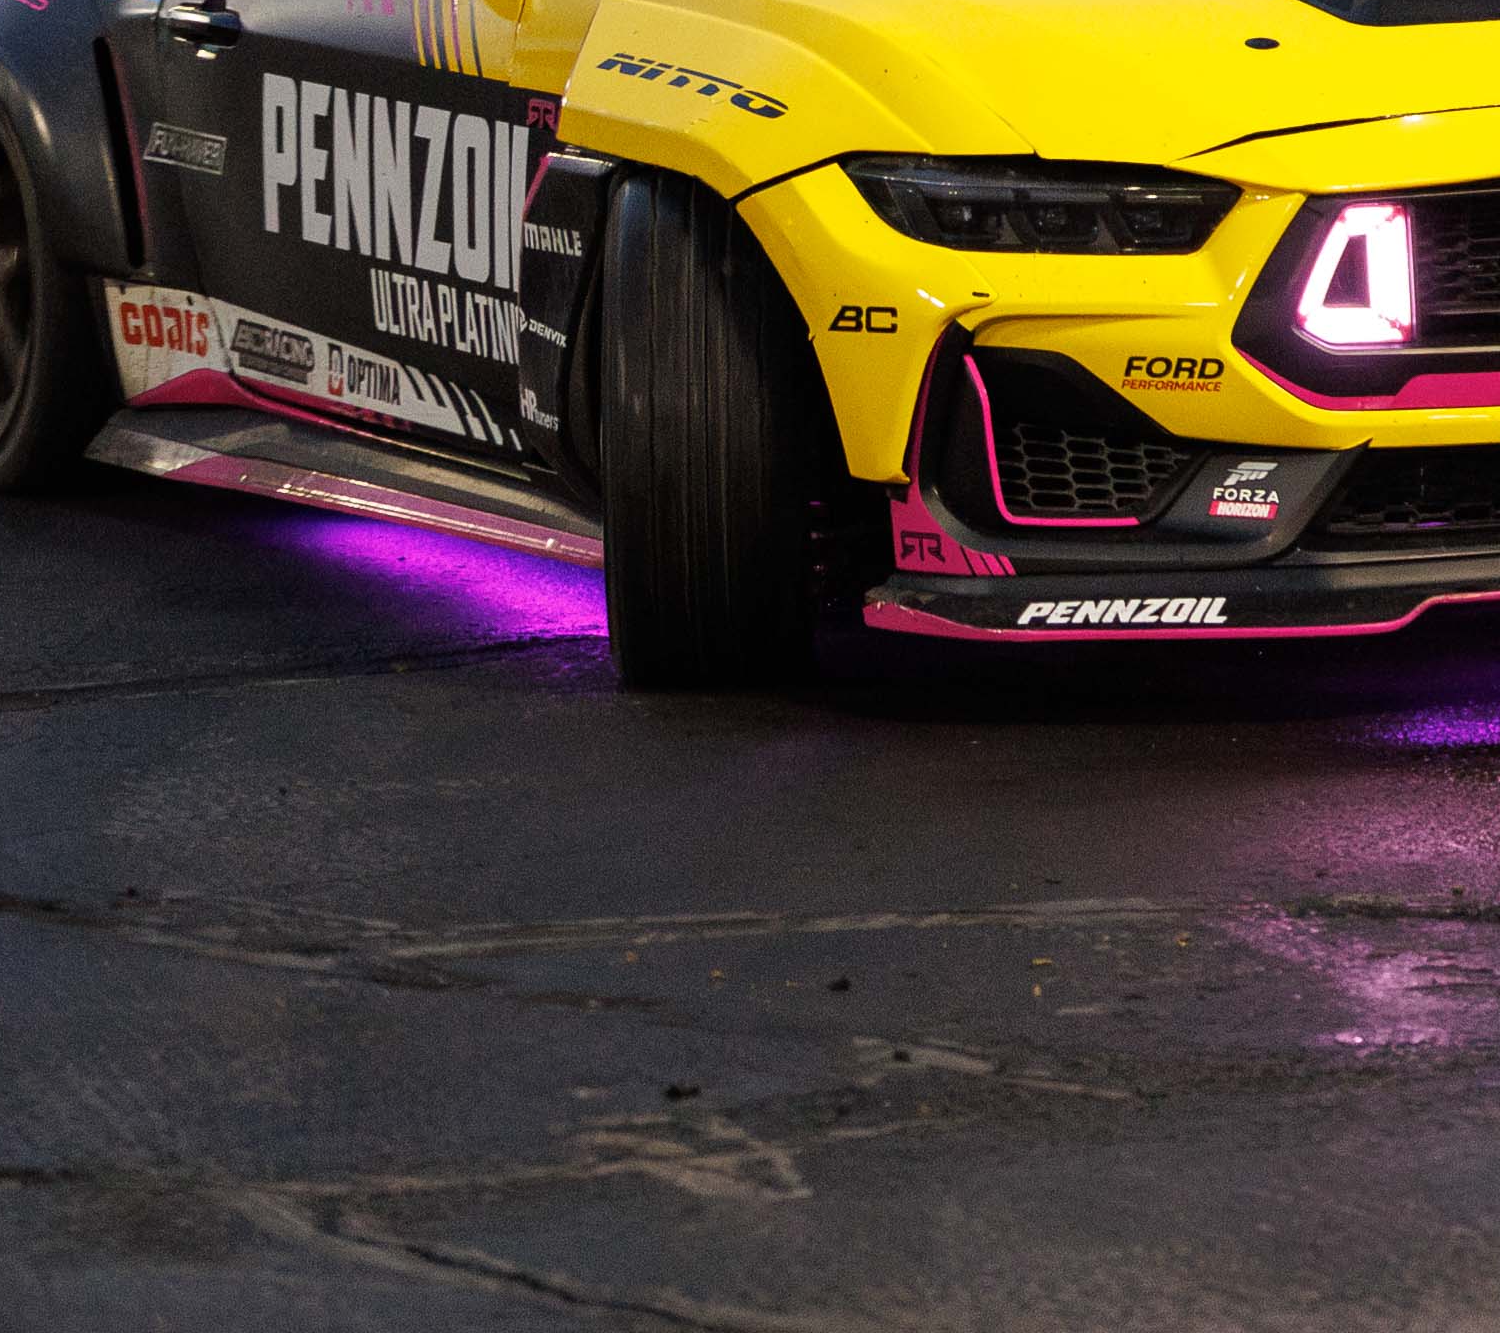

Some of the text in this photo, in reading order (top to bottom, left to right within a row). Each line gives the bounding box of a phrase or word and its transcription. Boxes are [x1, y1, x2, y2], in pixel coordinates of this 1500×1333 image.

[596, 52, 789, 119] NITTO
[524, 221, 583, 257] MAHLE
[370, 268, 438, 348] ULTRA
[828, 305, 898, 334] BC
[347, 353, 401, 406] OPTIMA
[1124, 355, 1225, 380] FORD
[1120, 379, 1223, 393] PERFORMANCE
[1212, 487, 1280, 504] FORZA
[1215, 502, 1271, 519] HORIZON
[1016, 595, 1229, 626] PENNZOIL
